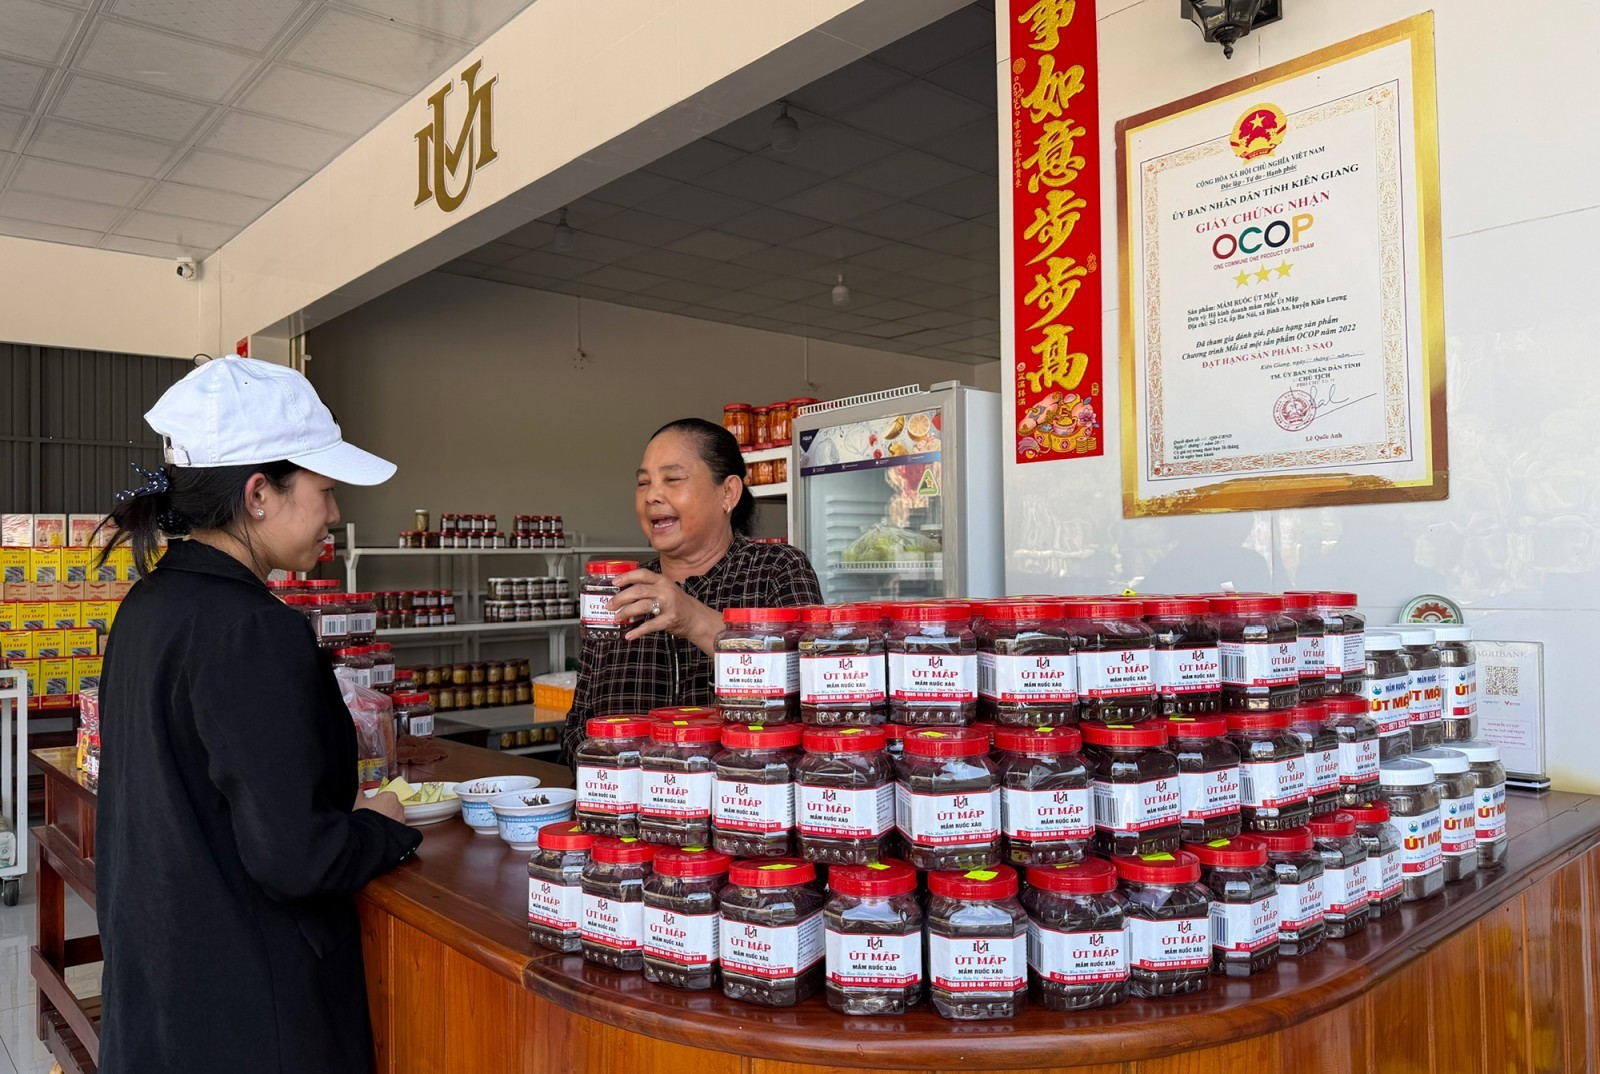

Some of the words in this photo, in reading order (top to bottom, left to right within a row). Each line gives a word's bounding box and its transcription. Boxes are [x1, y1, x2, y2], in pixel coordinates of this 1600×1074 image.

[1196, 179, 1213, 188] CỘNG
[1215, 174, 1228, 184] HÒA
[1229, 171, 1238, 179] XÃ
[1240, 167, 1251, 176] HỘI
[1253, 162, 1266, 173] CHỦ
[1268, 155, 1290, 168] NGHĨA
[1291, 151, 1308, 160] VIỆT
[1309, 146, 1325, 155] NAM
[1221, 182, 1231, 190] Độc
[1267, 168, 1282, 178] Hạnh
[1284, 164, 1297, 174] phúc
[1172, 209, 1186, 221] ỦY
[1188, 205, 1207, 217] BAN
[1209, 196, 1237, 211] NHÂN
[1240, 191, 1261, 204] DÂN
[1264, 183, 1289, 196] TỈNH
[1292, 174, 1318, 189] KIÊN
[1321, 164, 1359, 180] GIANG
[1232, 203, 1284, 224] CHỨNG
[1288, 190, 1330, 211] NHẬN
[1212, 213, 1314, 260] OCOP
[1225, 258, 1248, 268] COMMUNE
[1261, 250, 1283, 261] PRODUCT
[1292, 242, 1315, 253] VIETNAM
[1276, 333, 1295, 344] phẩm
[1297, 330, 1319, 340] OCOP
[1338, 324, 1356, 333] 2022
[1202, 359, 1220, 369] ĐẠT
[1222, 354, 1248, 365] HẠNG
[1251, 350, 1269, 359] SẢN
[1272, 345, 1303, 357] PHẨM:
[1313, 340, 1333, 350] SAO
[727, 666, 741, 675] ÚT
[743, 666, 765, 678] MẬP
[1107, 665, 1123, 675] ÚT
[1124, 663, 1149, 675] MẬP
[1179, 663, 1196, 672] ÚT
[1196, 661, 1218, 672] MẬP
[823, 671, 840, 681] ÚT
[843, 671, 869, 682] MẬP
[912, 669, 929, 678] ÚT
[932, 668, 958, 680] MẬP
[1021, 670, 1038, 679] ÚT
[1040, 670, 1065, 681] MẬP
[1370, 696, 1390, 712] ÚT
[1392, 693, 1410, 709] MẬ
[650, 785, 665, 795] ÚT
[666, 786, 688, 797] MẬP
[721, 795, 736, 804] ÚT
[738, 796, 762, 808] MẬP
[807, 802, 824, 812] ÚT
[826, 803, 852, 816] MẬP
[937, 810, 955, 820] ÚT
[958, 810, 985, 820] MẬP
[1038, 806, 1055, 816] ÚT
[1058, 804, 1084, 817] MẬP
[1404, 836, 1425, 850] ÚT
[585, 908, 598, 918] ÚT
[599, 911, 619, 924] MẬP
[650, 922, 663, 933] ÚT
[665, 926, 686, 940] MẬP
[730, 937, 745, 947] ÚT
[747, 940, 771, 953] MẬP
[1162, 936, 1179, 946] ÚT
[1181, 934, 1206, 946] MẬP
[849, 950, 868, 961] ÚT
[871, 951, 900, 963] MẬP
[1072, 949, 1089, 959] ÚT
[1092, 948, 1119, 960] MẬP
[955, 956, 974, 965] ÚT
[977, 955, 1007, 967] MẬP
